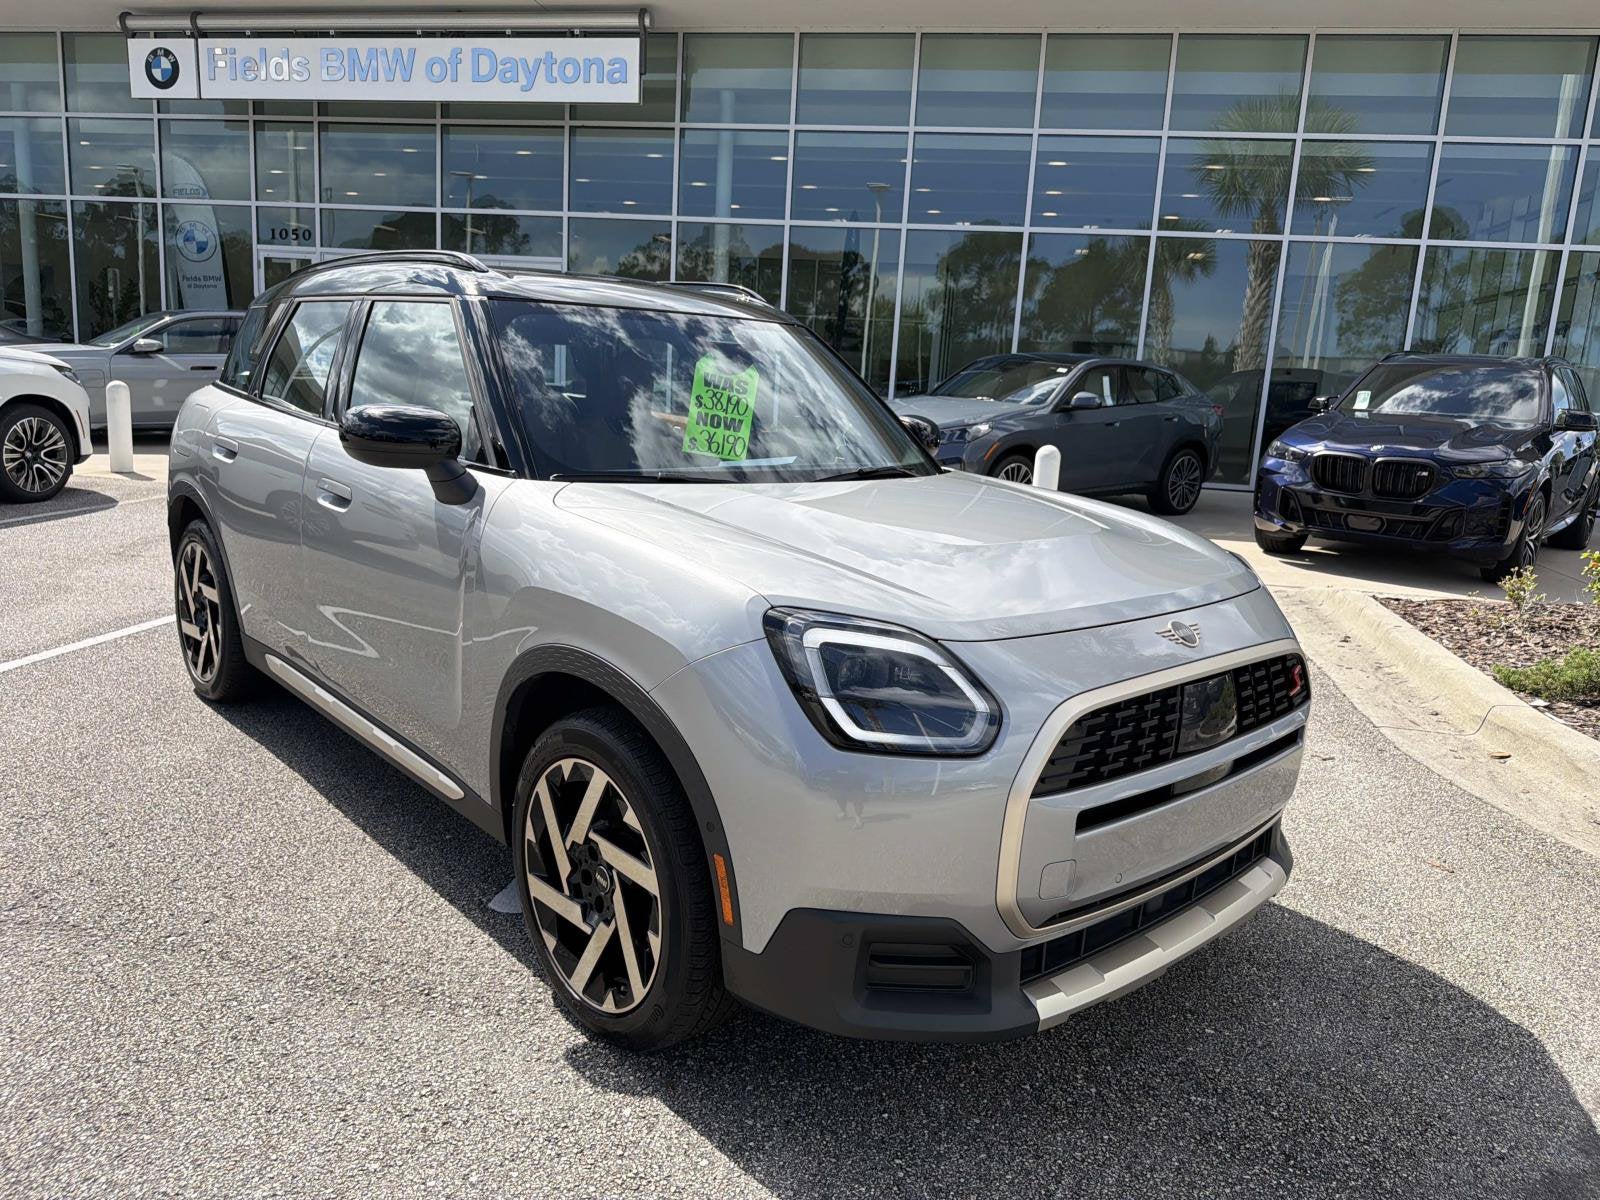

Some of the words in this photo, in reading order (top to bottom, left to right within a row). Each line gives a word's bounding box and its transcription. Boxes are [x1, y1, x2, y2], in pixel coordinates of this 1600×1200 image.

[147, 48, 176, 63] BMW
[206, 47, 311, 82] Fields
[320, 47, 416, 82] BMW
[425, 47, 463, 83] of
[470, 47, 628, 92] Daytona
[270, 228, 312, 241] 1050
[202, 274, 222, 282] BMW
[703, 372, 748, 395] WAS
[695, 411, 745, 433] NOW
